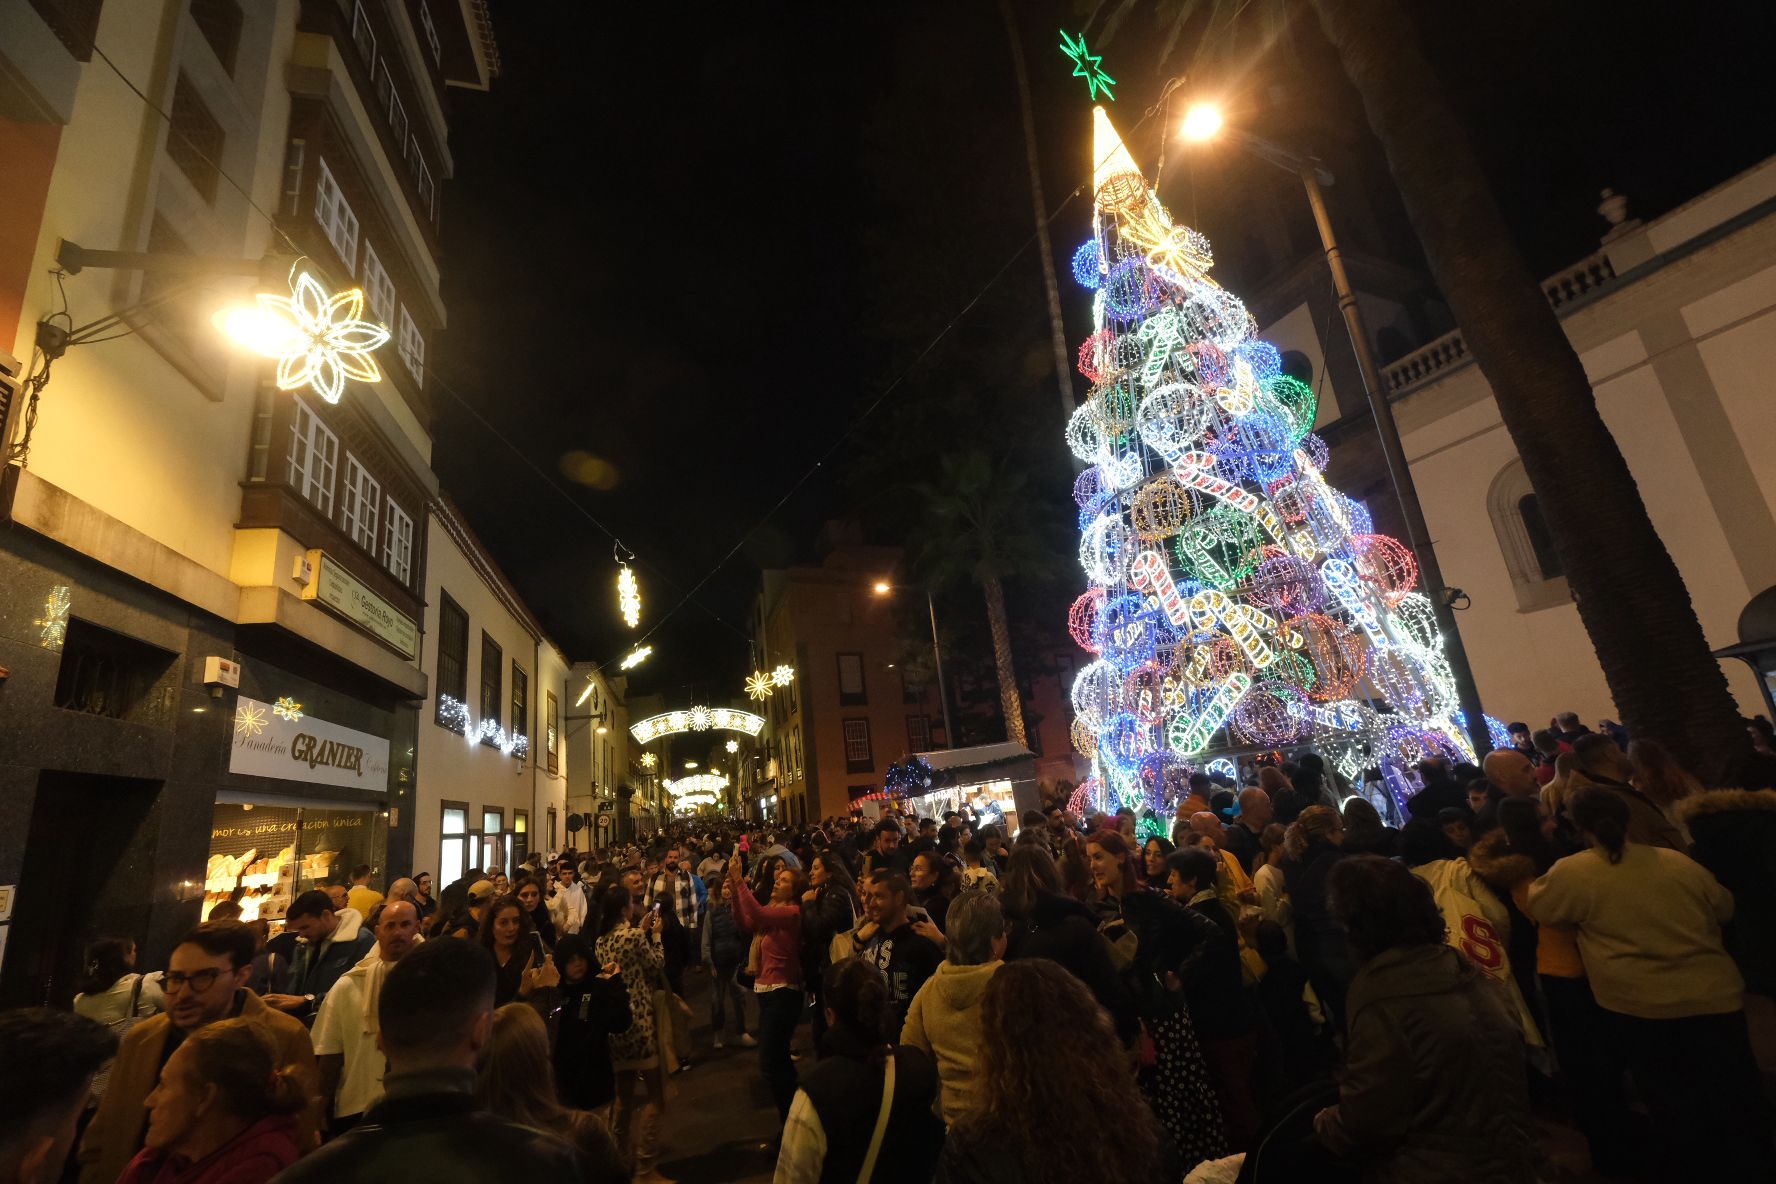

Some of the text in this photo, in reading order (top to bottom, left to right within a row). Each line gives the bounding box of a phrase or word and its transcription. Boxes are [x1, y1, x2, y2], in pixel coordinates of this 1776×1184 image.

[291, 733, 364, 777] GRANIER
[211, 828, 235, 839] mor
[255, 824, 278, 834] una
[333, 815, 362, 828] única
